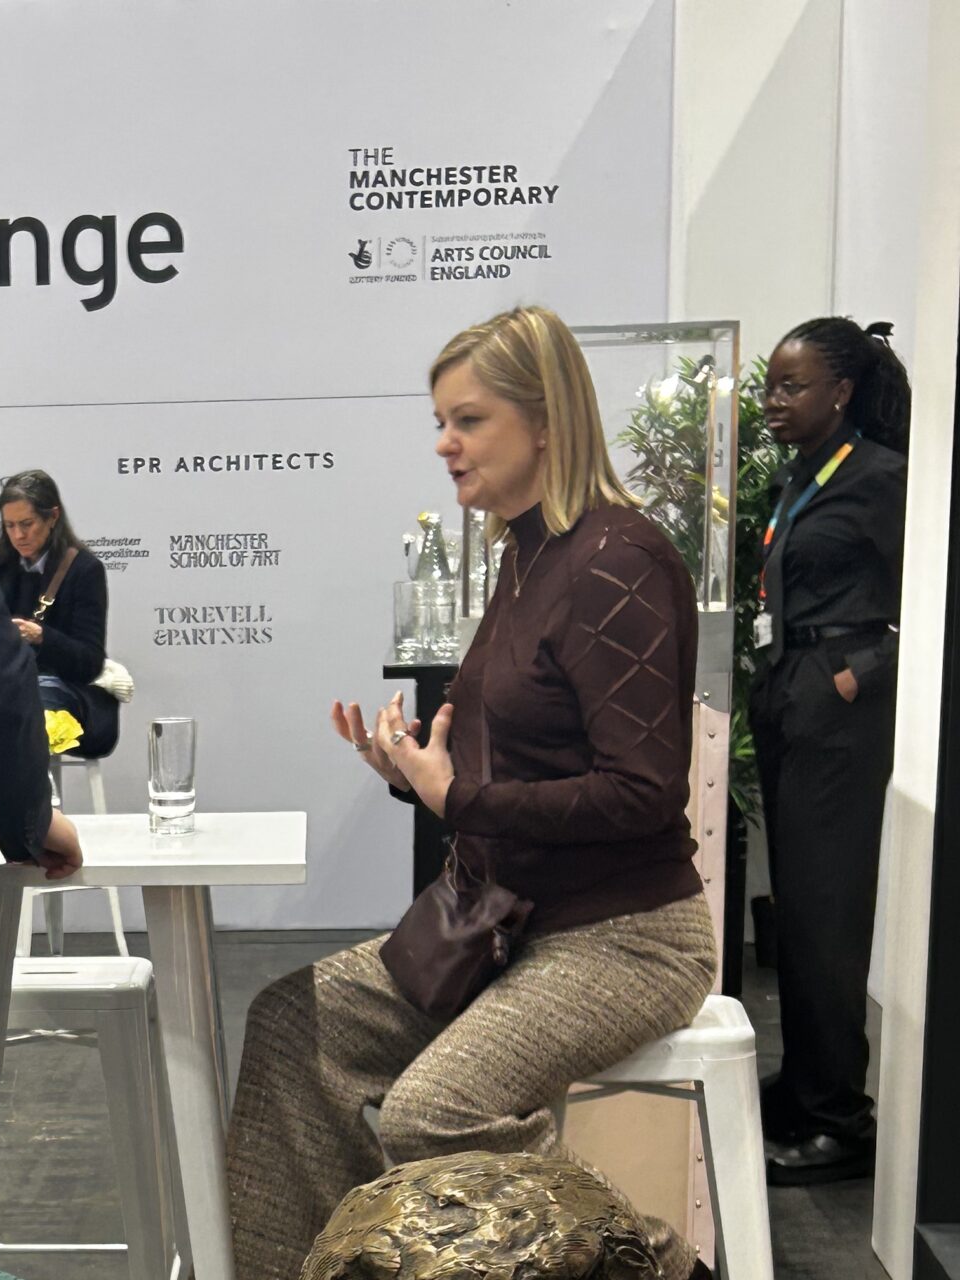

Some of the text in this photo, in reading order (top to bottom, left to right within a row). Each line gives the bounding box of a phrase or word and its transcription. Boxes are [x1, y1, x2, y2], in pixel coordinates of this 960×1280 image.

[348, 147, 394, 166] THE
[349, 165, 518, 188] MANCHESTER
[349, 185, 559, 211] CONTEMPORARY
[431, 248, 475, 262] ARTS
[479, 245, 552, 261] COUNCIL
[430, 264, 511, 281] ENGLAND
[117, 452, 334, 474] EPR ARCHITECTS
[169, 533, 268, 551] MANCHESTER
[170, 550, 282, 569] SCHOOL OF ART
[154, 605, 273, 624] TOREVELL
[153, 626, 273, 646] &PARTNERS
